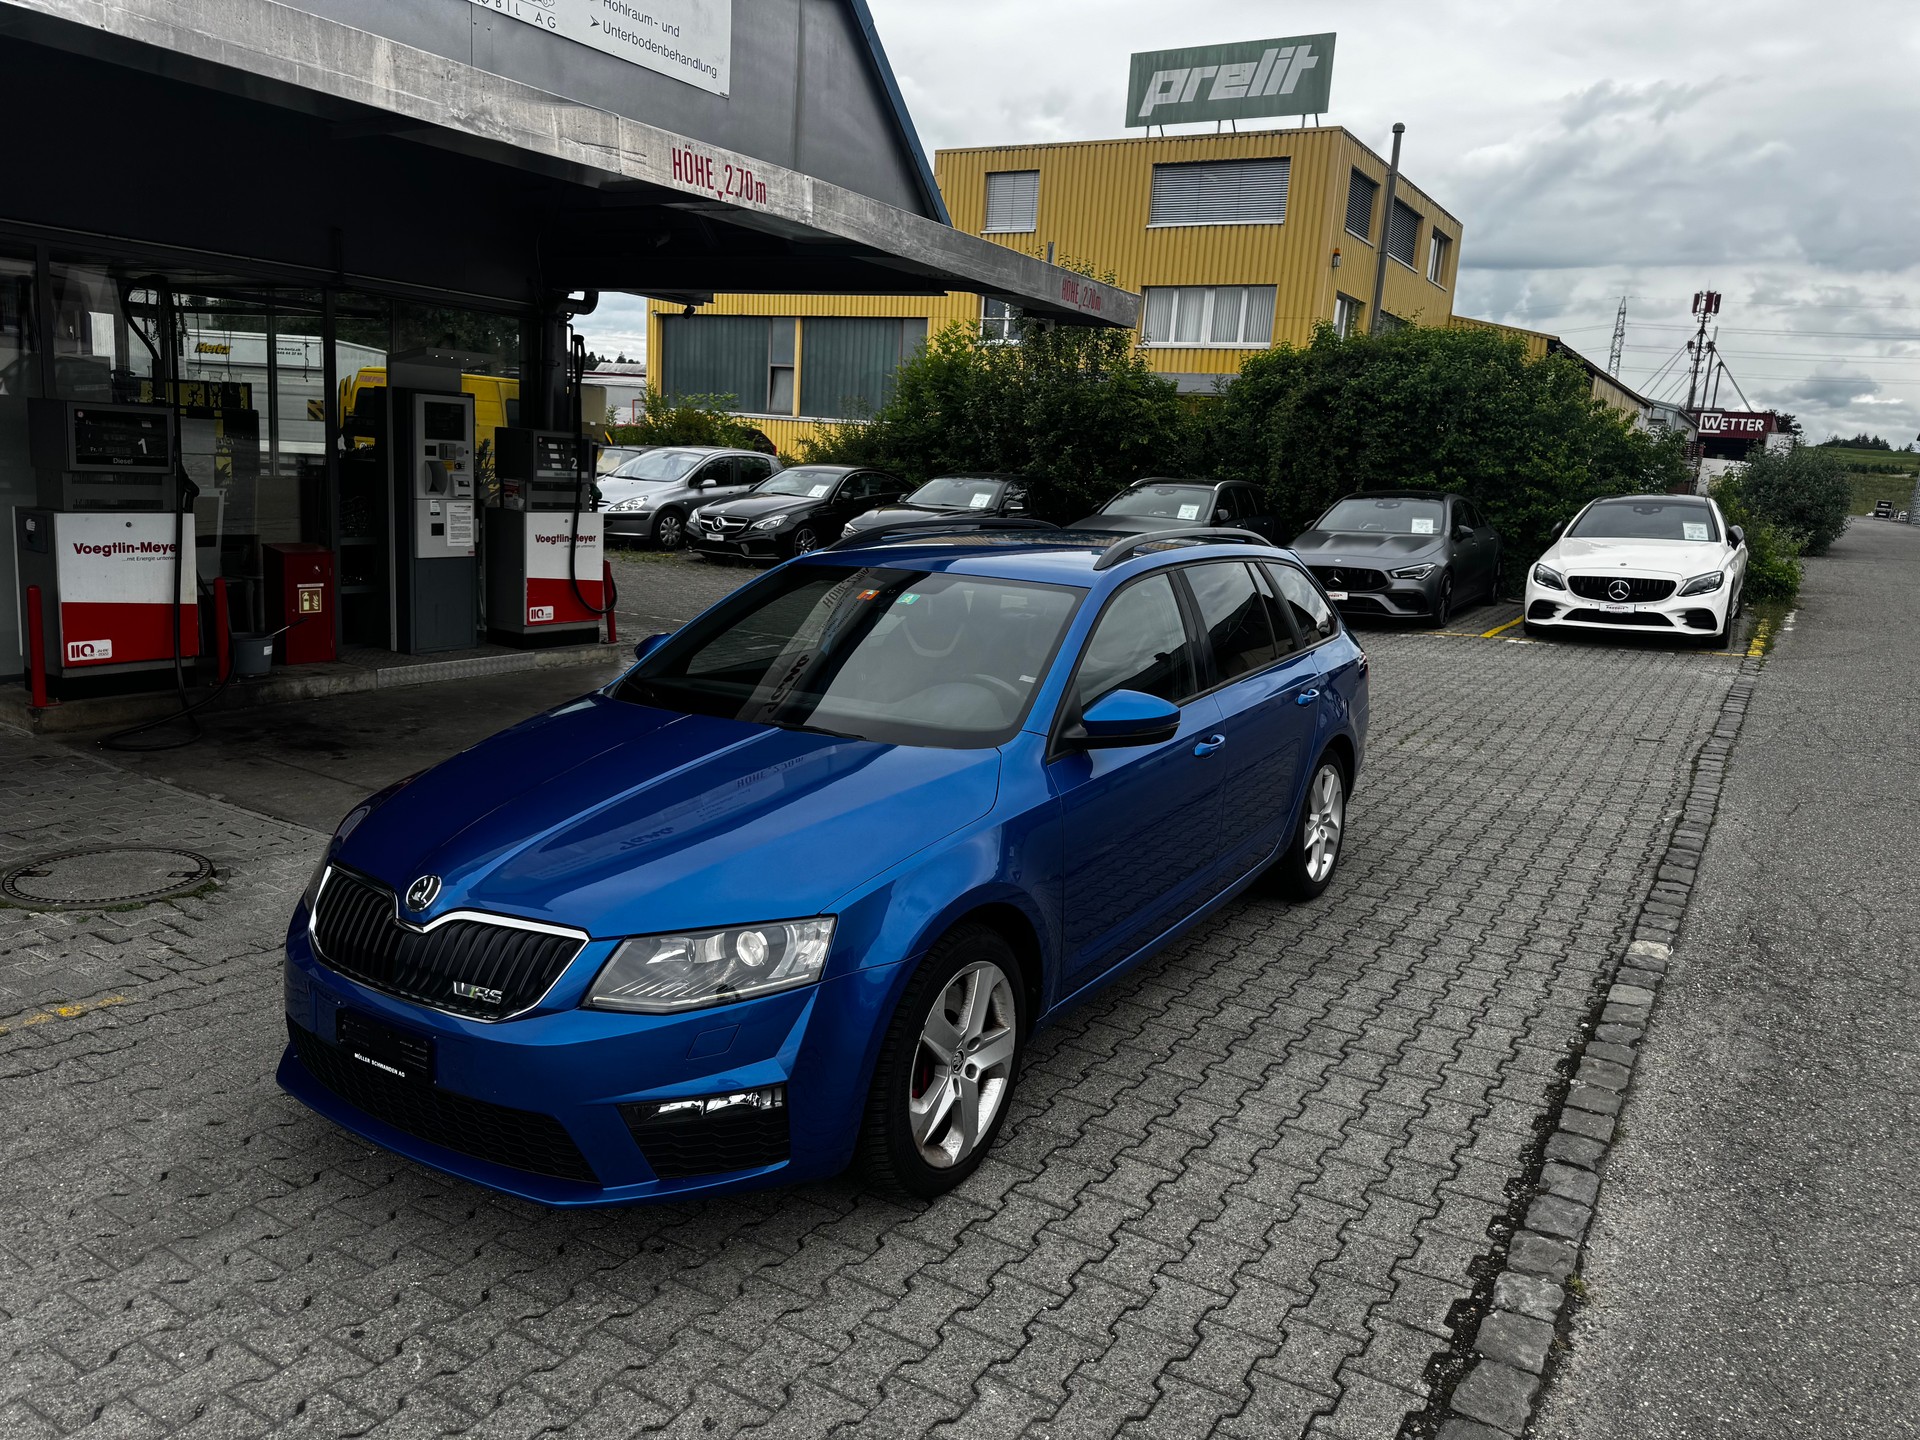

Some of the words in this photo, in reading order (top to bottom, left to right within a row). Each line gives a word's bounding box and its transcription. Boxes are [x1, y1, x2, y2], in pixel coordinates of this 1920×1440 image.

[535, 11, 557, 29] AG
[661, 22, 680, 38] und
[602, 20, 718, 79] Unterbodenbehandlung
[1138, 44, 1319, 117] prelit
[672, 144, 714, 190] HÖHE
[1061, 275, 1080, 304] HÖHE
[1702, 416, 1765, 432] WETTER
[137, 437, 148, 455] 1
[112, 457, 134, 465] Diesel
[570, 457, 578, 470] 2
[73, 541, 177, 557] Voegtlin-Meye
[398, 1070, 406, 1078] AG
